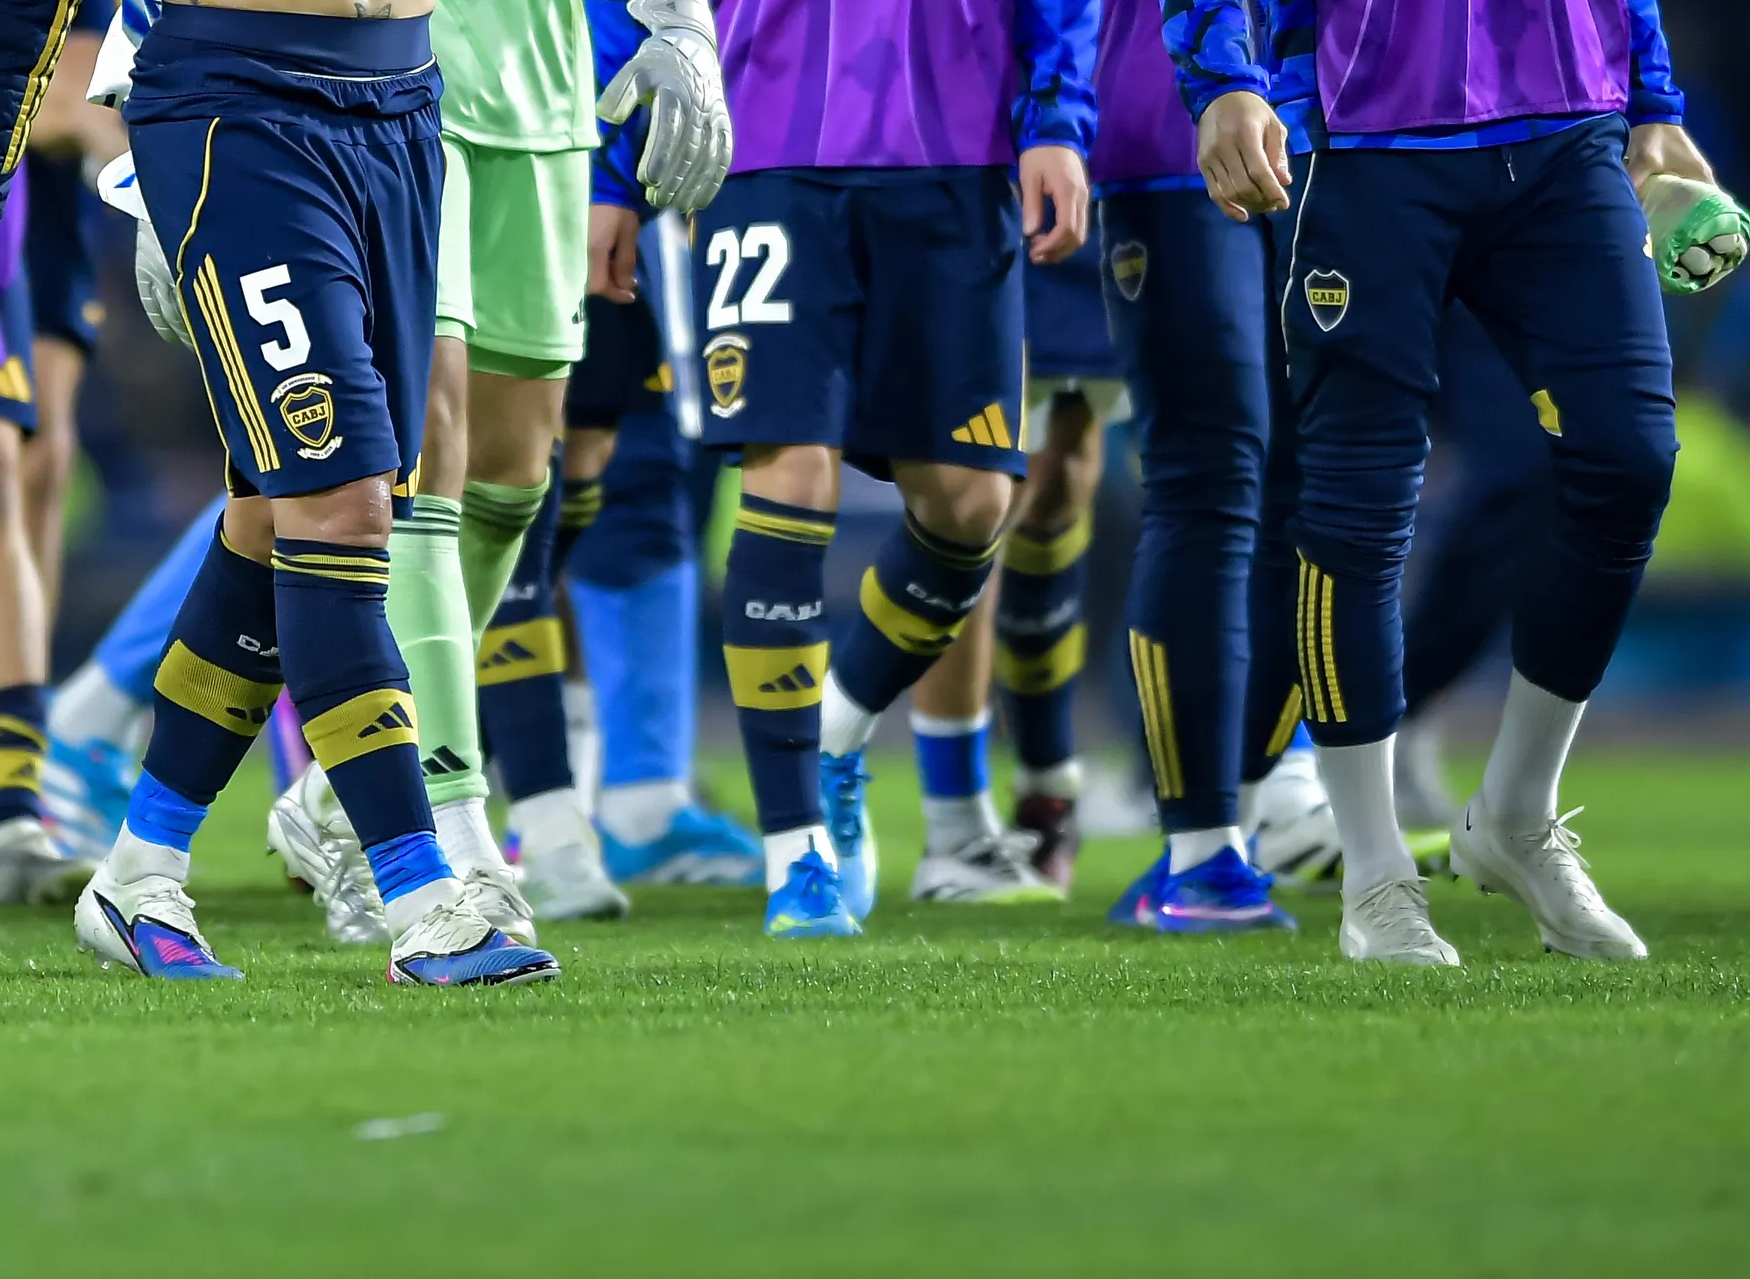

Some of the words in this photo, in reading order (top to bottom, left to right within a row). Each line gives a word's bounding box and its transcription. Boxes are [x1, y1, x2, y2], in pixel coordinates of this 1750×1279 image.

[706, 222, 792, 330] 22
[1312, 291, 1343, 303] CABJ
[239, 263, 312, 372] 5
[291, 405, 327, 425] CABJ
